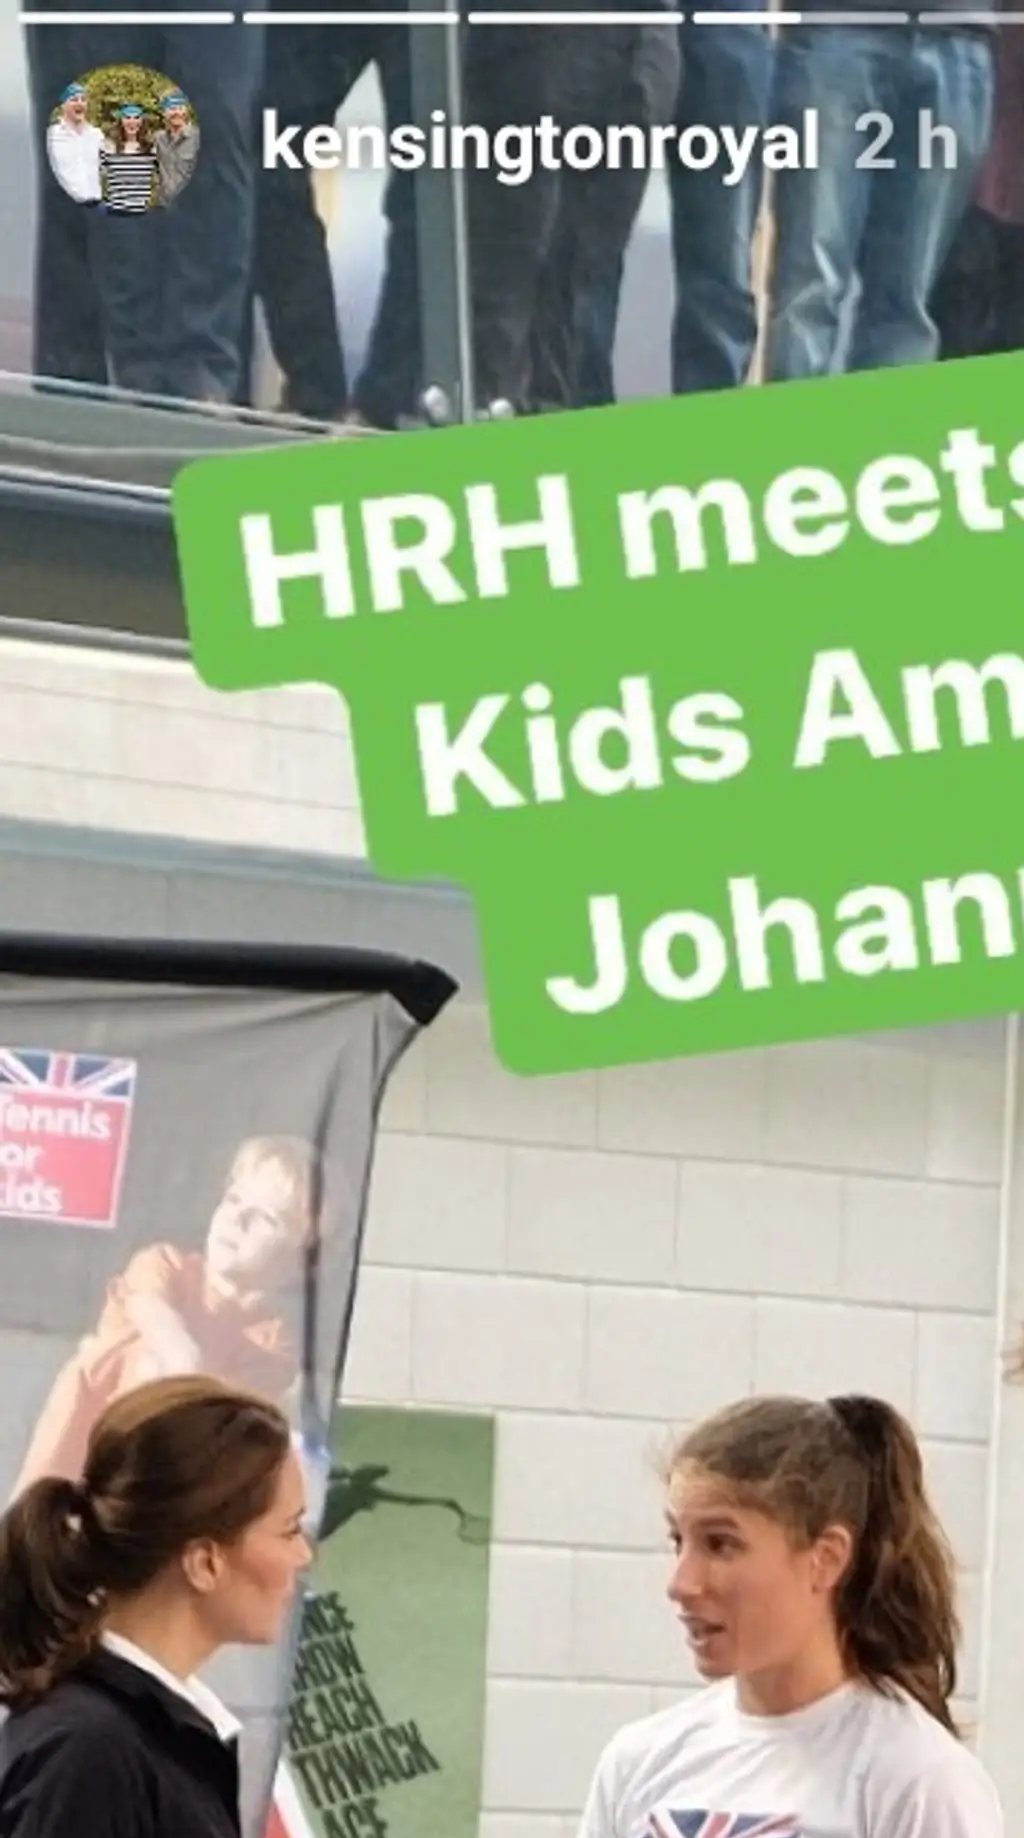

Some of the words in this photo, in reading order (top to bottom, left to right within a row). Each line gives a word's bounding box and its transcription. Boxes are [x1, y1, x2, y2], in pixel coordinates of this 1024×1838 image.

[0, 1144, 44, 1171] or
[0, 1173, 63, 1212] ids
[290, 1718, 441, 1811] THWACK
